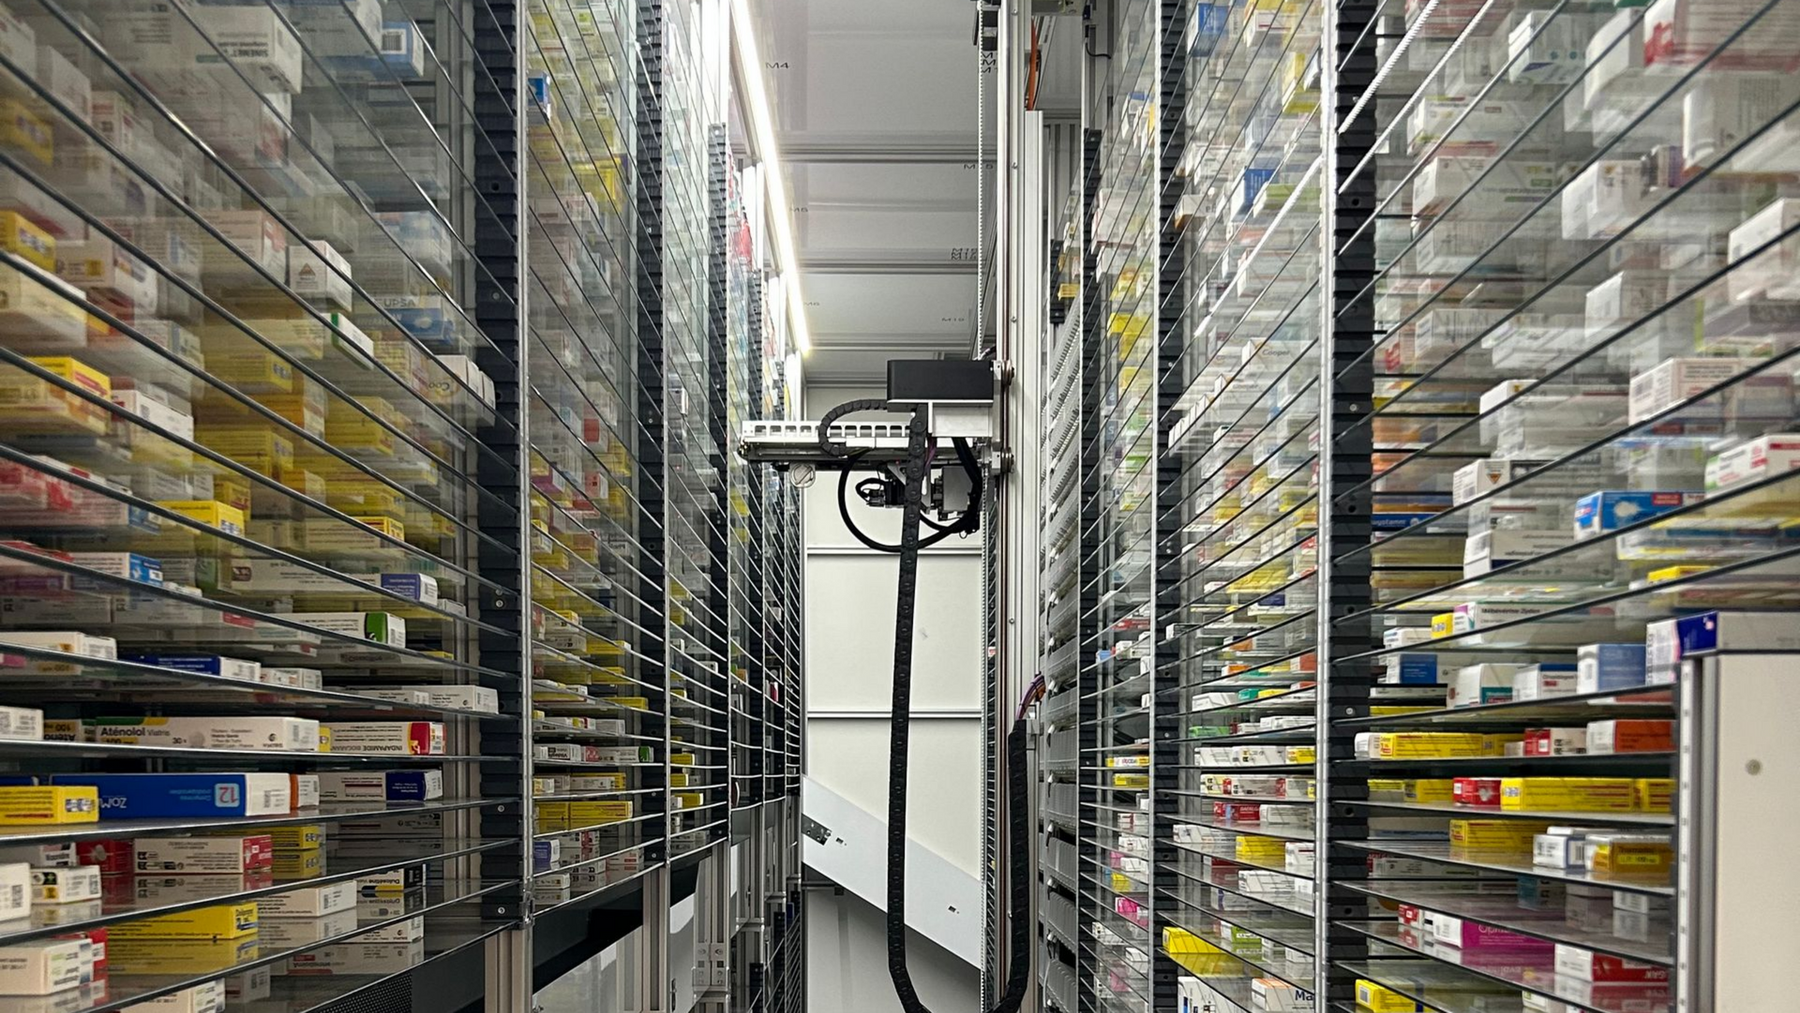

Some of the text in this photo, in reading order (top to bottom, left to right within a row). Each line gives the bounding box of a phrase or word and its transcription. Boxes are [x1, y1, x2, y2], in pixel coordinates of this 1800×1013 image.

[1263, 349, 1290, 357] Cooper
[100, 727, 145, 737] Aténolol
[219, 787, 238, 803] 12
